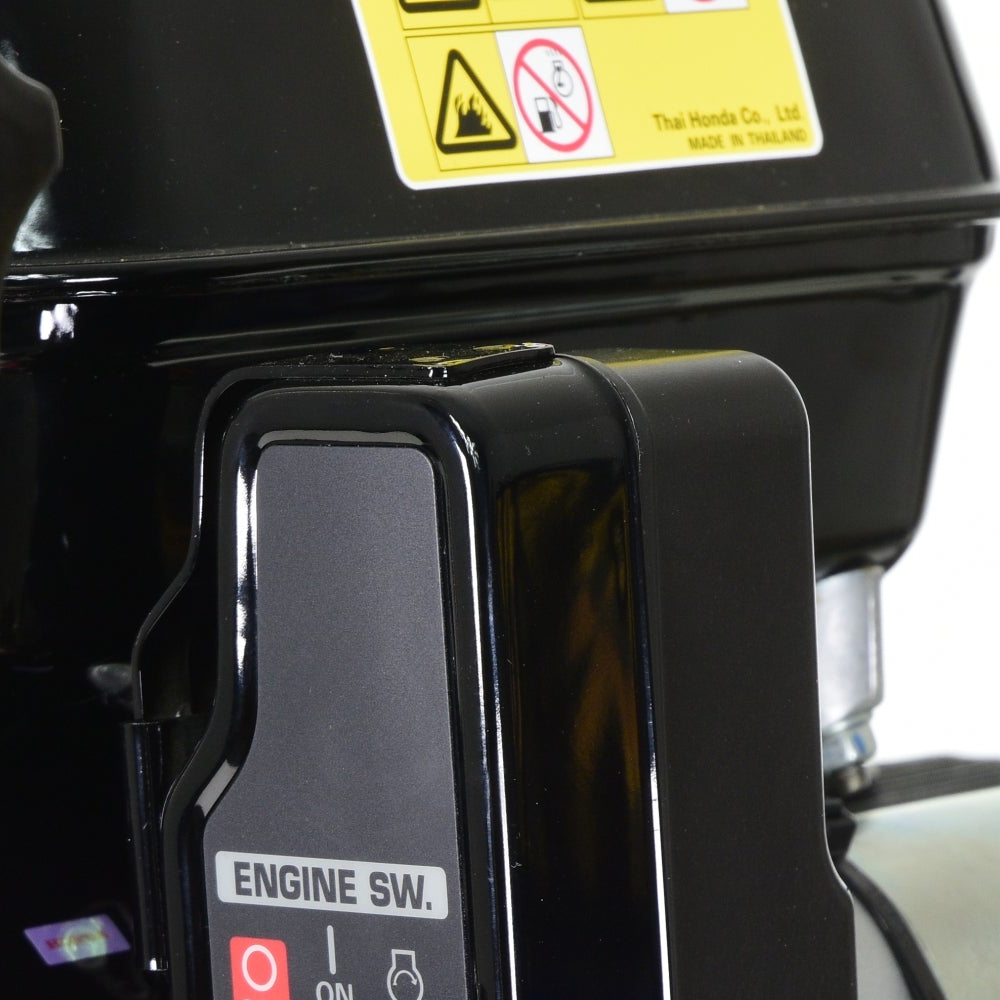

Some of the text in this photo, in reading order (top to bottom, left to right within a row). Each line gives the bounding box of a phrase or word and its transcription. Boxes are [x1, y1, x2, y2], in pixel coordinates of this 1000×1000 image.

[652, 112, 686, 131] Thai
[688, 108, 738, 128] Honda
[688, 128, 807, 150] MADE IN THAILAND
[233, 860, 433, 911] ENGINE SW.
